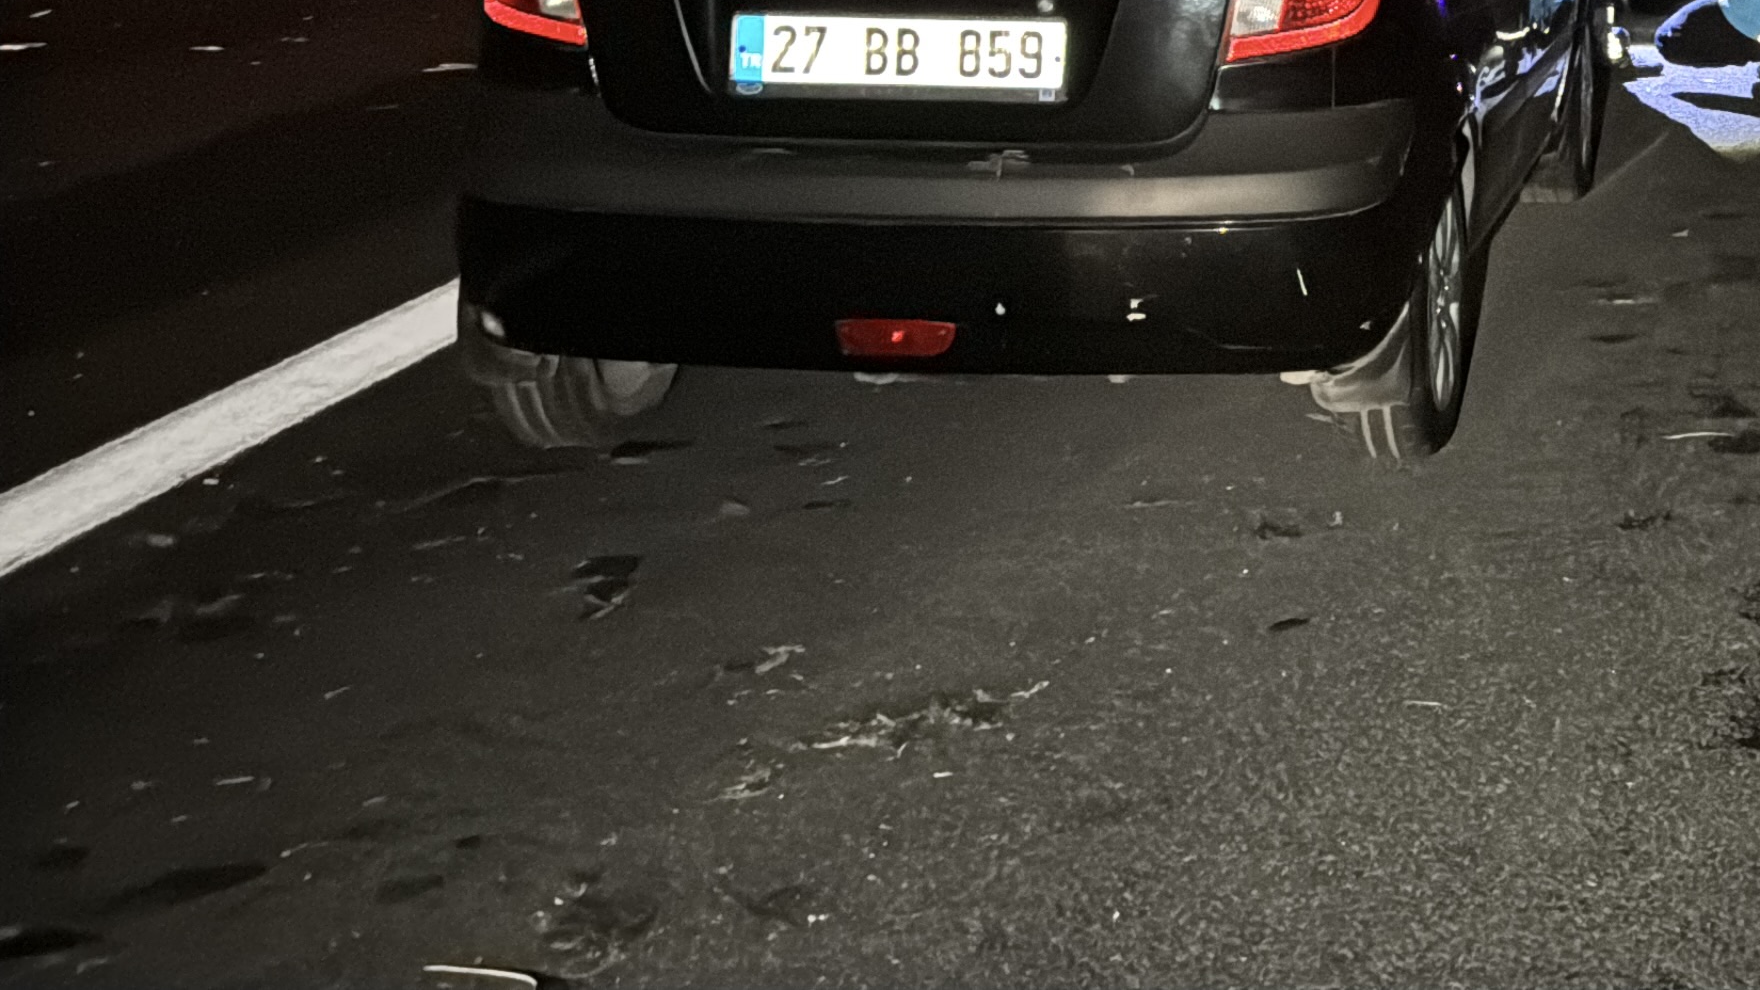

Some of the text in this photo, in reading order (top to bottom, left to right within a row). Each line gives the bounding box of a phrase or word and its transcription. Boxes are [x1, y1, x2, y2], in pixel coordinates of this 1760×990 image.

[740, 25, 1043, 79] TR 27 BB 859
